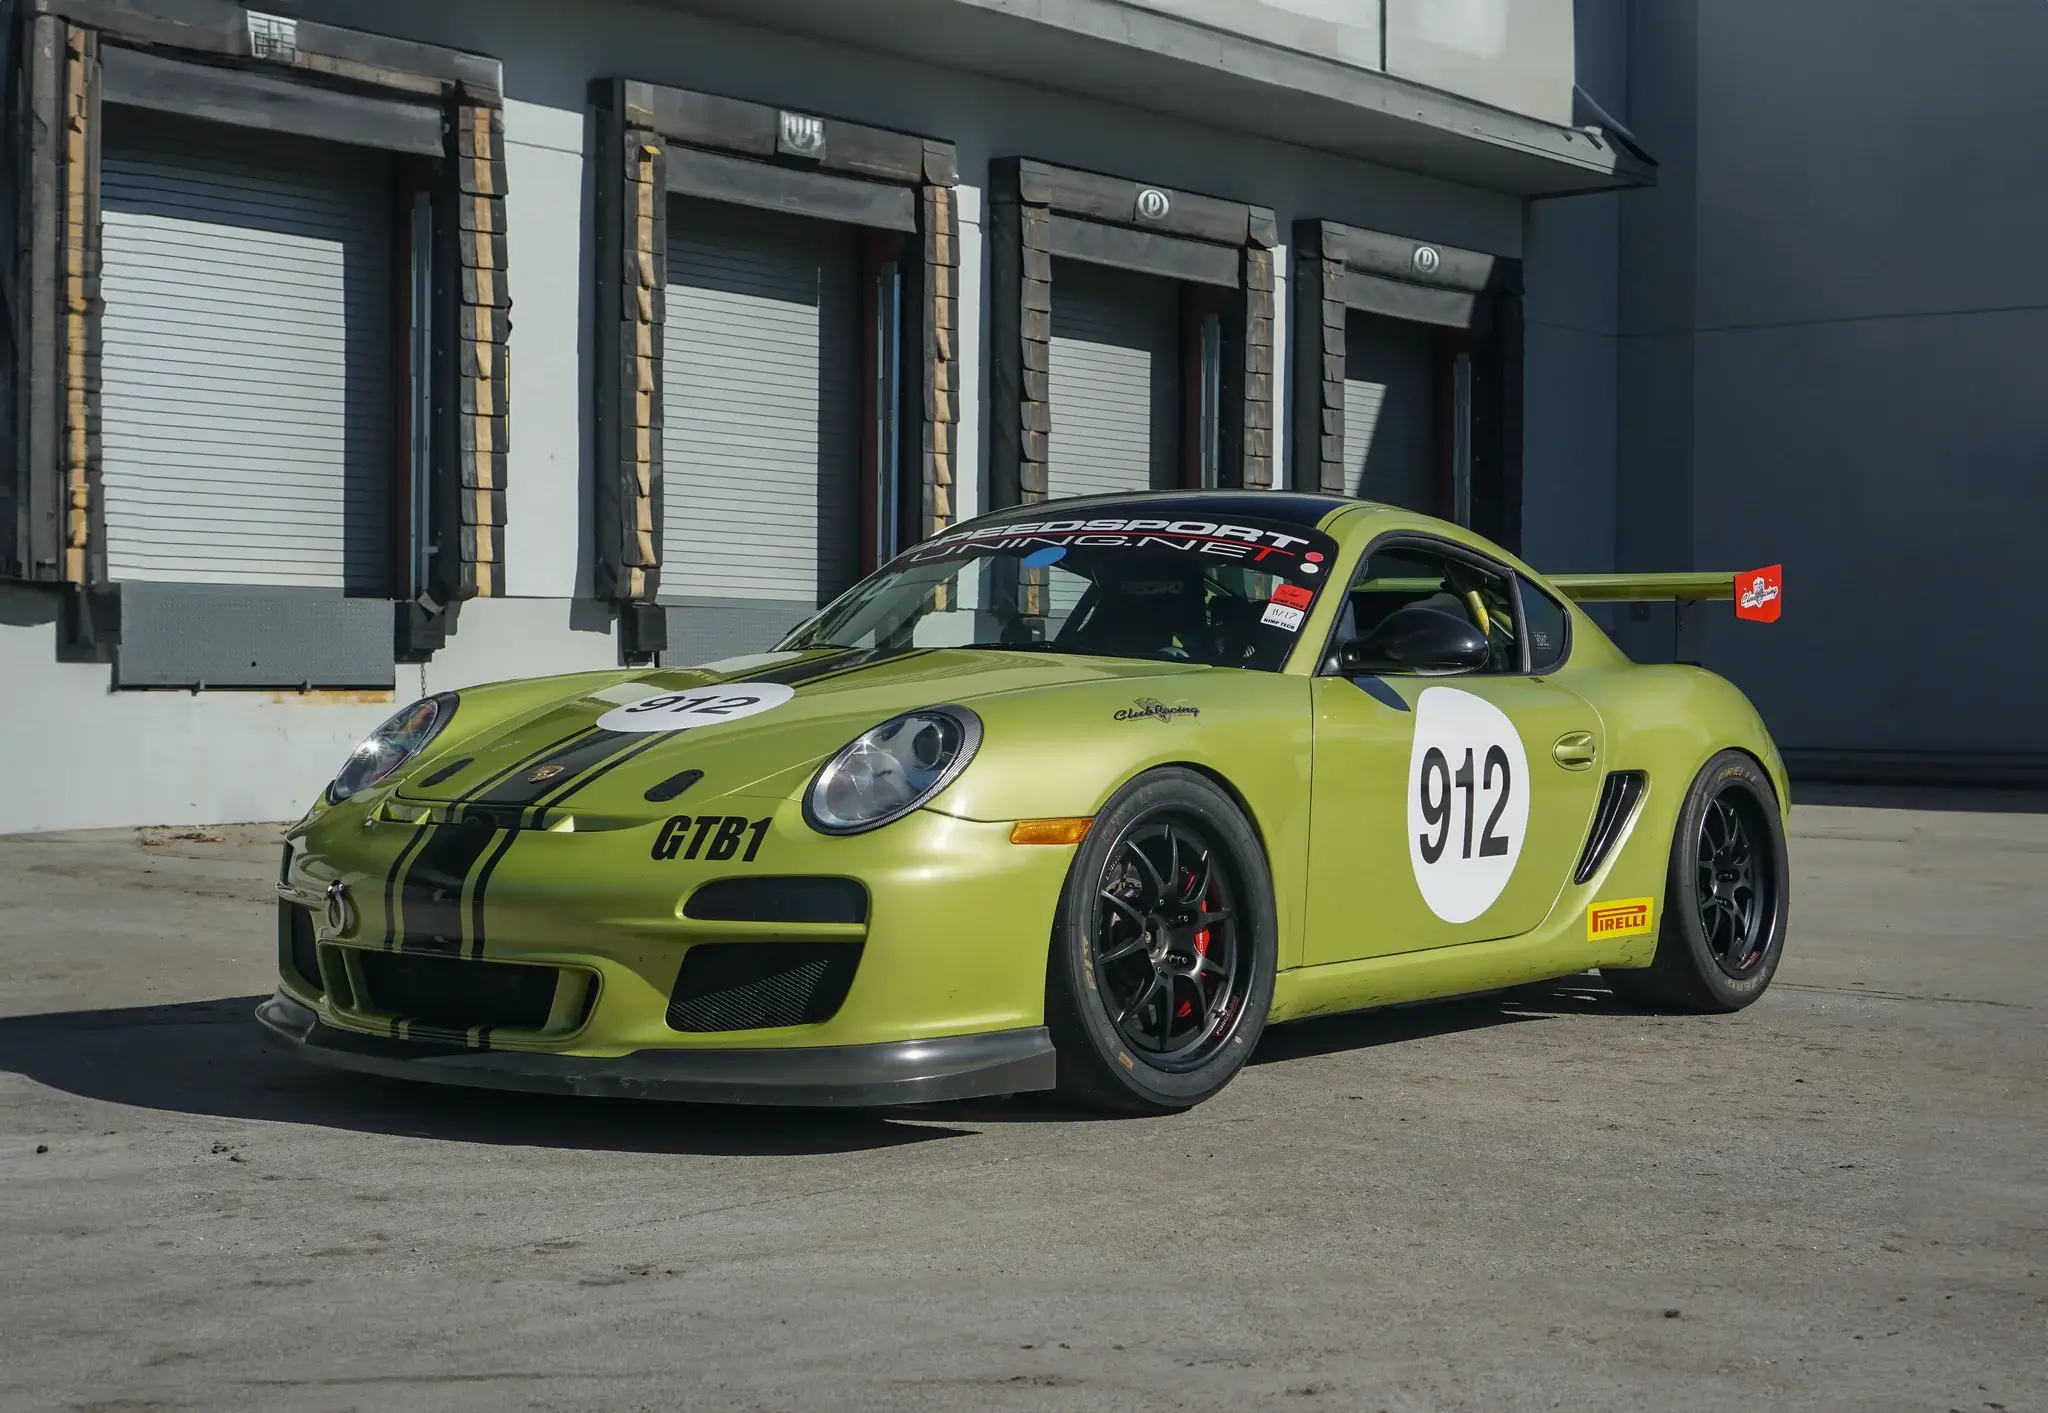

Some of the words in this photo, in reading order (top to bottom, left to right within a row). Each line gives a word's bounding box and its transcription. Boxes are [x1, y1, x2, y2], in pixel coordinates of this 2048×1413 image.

[899, 519, 1310, 557] SPEEDSPORT
[1281, 621, 1295, 630] TECH
[625, 695, 761, 714] 912
[1420, 744, 1511, 864] 912
[650, 815, 773, 862] GTB1
[1592, 905, 1647, 933] PIRELLI
